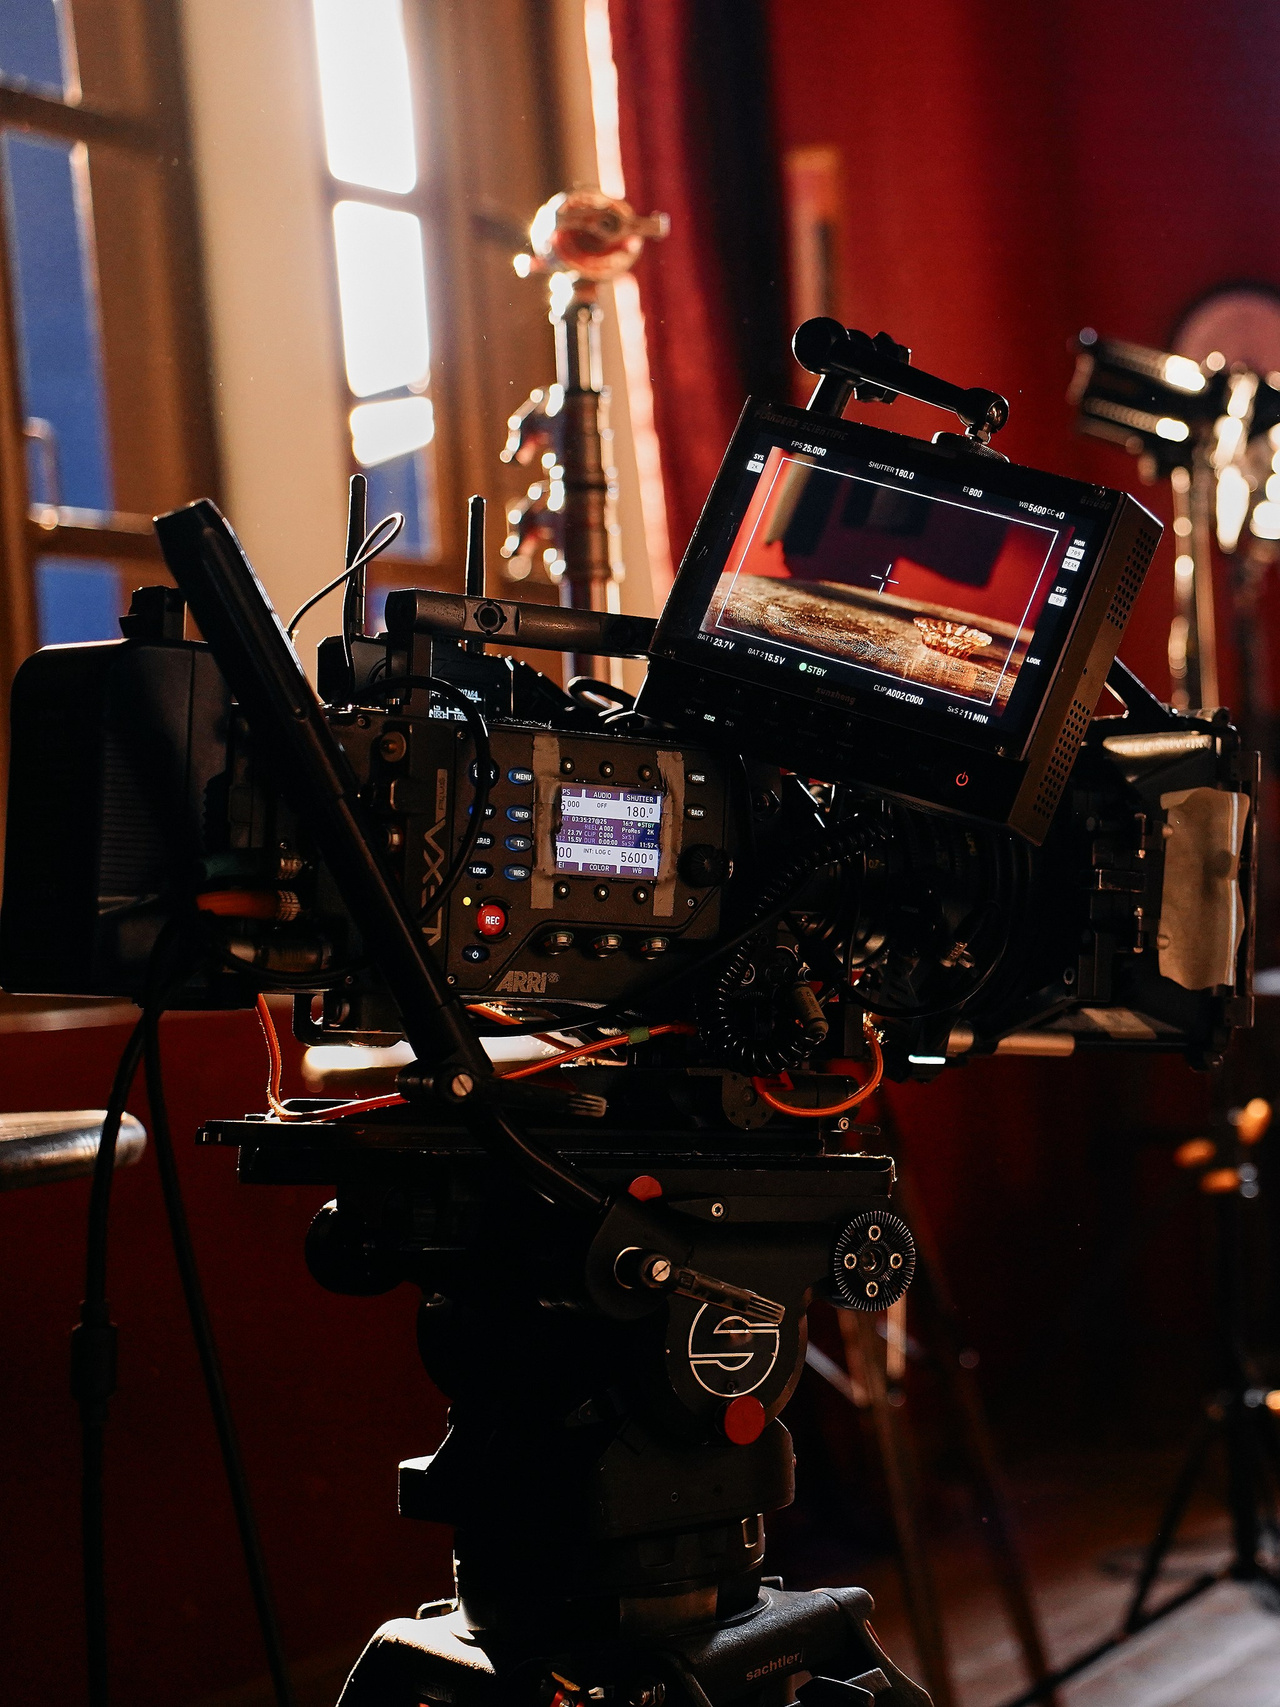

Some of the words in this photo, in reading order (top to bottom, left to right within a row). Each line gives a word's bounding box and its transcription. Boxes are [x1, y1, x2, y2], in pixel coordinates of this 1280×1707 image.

[791, 440, 803, 449] FPS
[802, 443, 827, 457] 25.000
[753, 453, 765, 461] SYS
[868, 460, 895, 474] SHUTTER
[894, 467, 915, 480] 180.0
[968, 487, 983, 498] 800
[1018, 501, 1029, 509] WB
[1028, 502, 1047, 515] 5600
[697, 633, 710, 642] BAT
[713, 638, 735, 651] 23.7V
[747, 648, 760, 657] BAT
[763, 652, 786, 665] 15.5V
[806, 665, 827, 677] STBY
[515, 772, 532, 781] MENU
[692, 774, 705, 782] HOME
[562, 788, 571, 796] PS
[593, 791, 612, 799] AUDIO
[626, 794, 654, 803] SHUTTER
[515, 811, 529, 819] INFO
[691, 809, 704, 817] BACK
[516, 840, 525, 848] TC
[557, 847, 572, 858] 00
[472, 866, 487, 875] LOCK
[589, 864, 610, 872] COLOR
[421, 818, 446, 947] LEXA
[485, 916, 500, 925] REC
